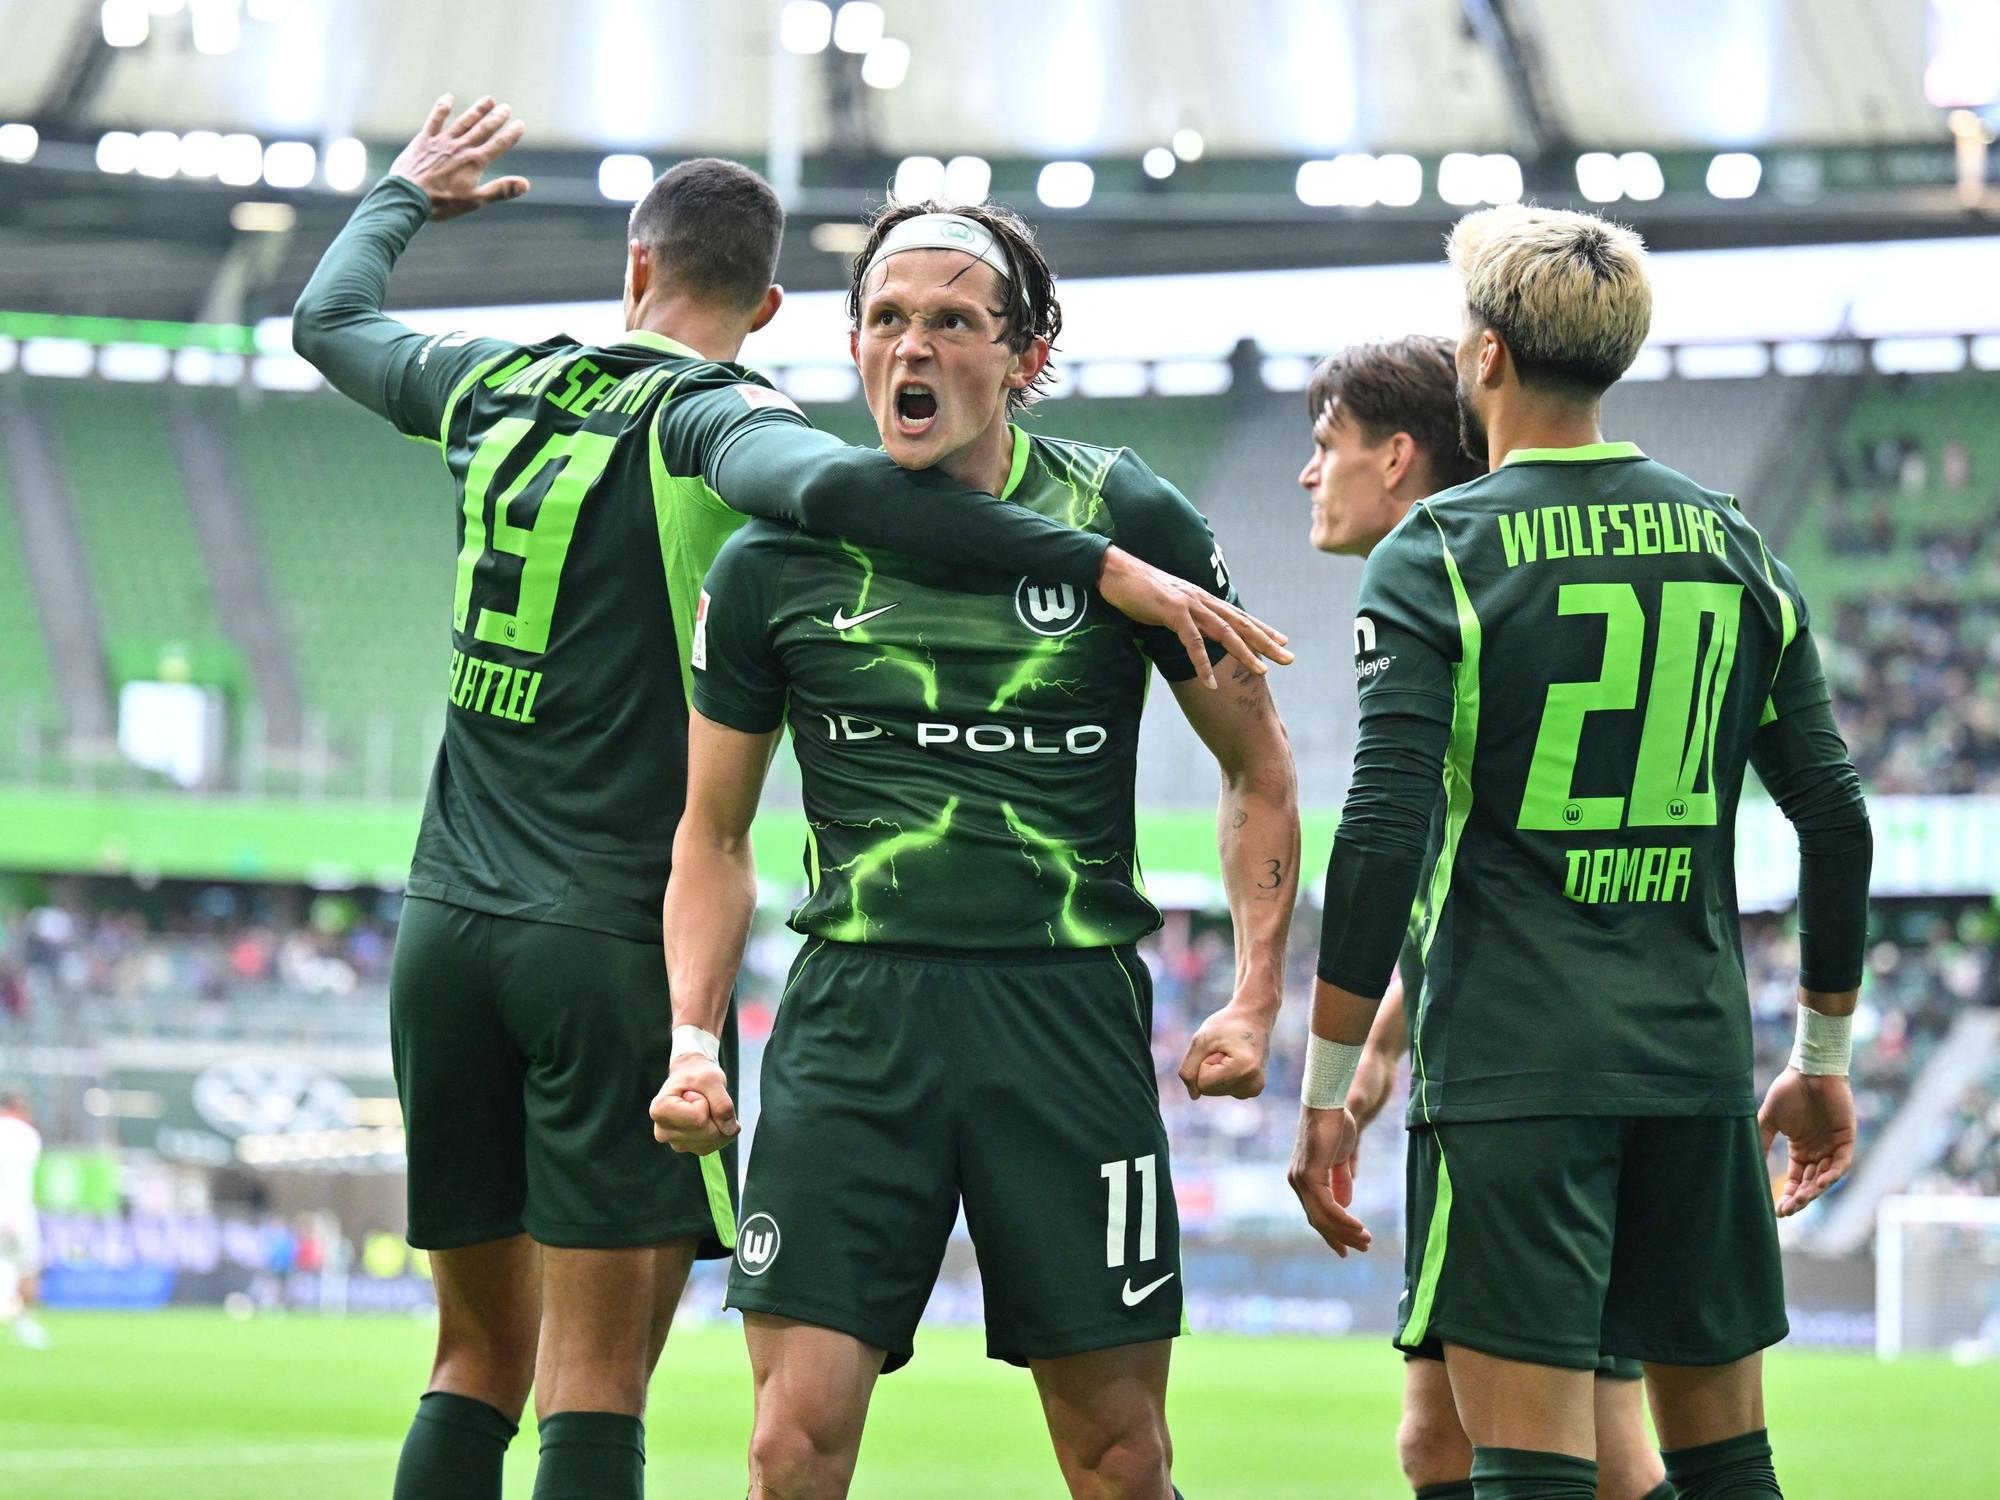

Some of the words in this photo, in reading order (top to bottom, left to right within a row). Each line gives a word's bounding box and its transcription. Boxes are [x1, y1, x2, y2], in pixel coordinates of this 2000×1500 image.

[453, 417, 617, 654] 19
[1498, 502, 1726, 567] WOLFSBURG
[917, 723, 1108, 755] POLO
[1516, 582, 1744, 830] 20
[1563, 847, 1692, 904] DAMAR
[1101, 1153, 1157, 1268] 11
